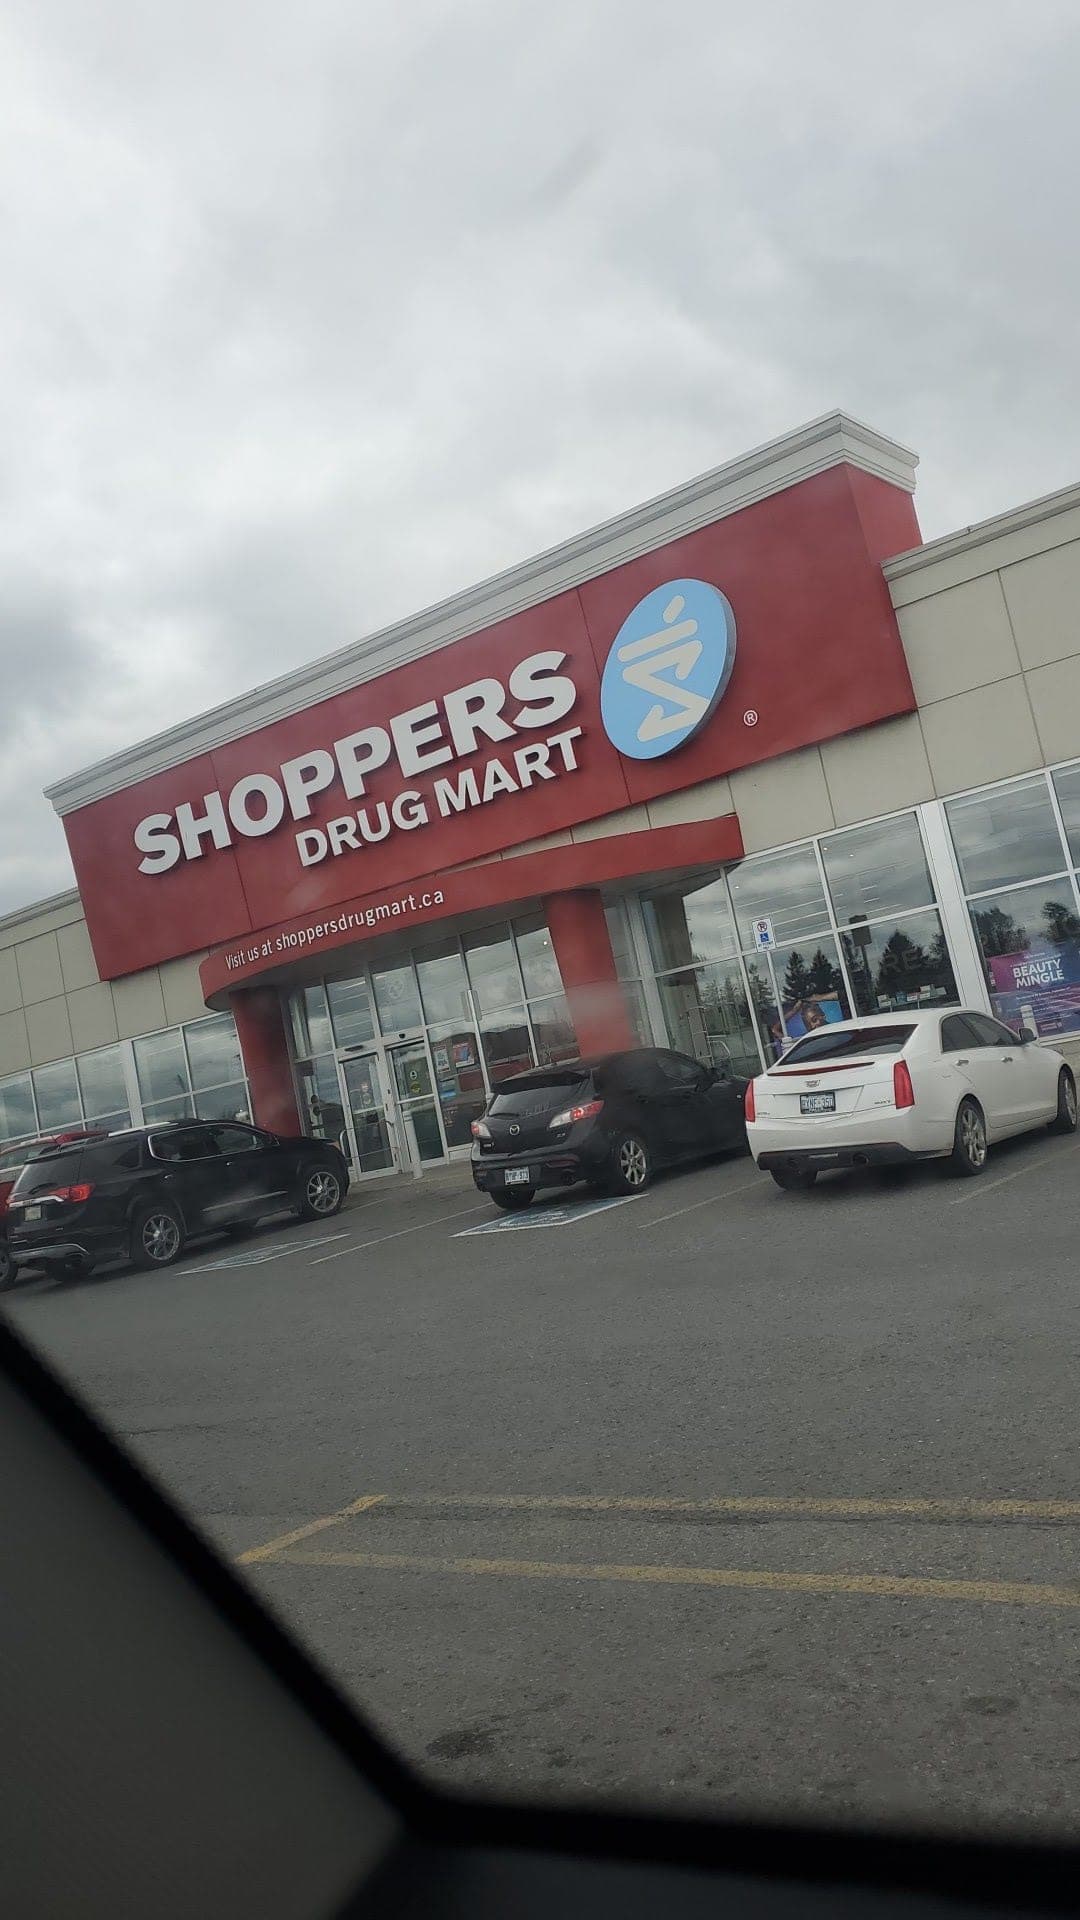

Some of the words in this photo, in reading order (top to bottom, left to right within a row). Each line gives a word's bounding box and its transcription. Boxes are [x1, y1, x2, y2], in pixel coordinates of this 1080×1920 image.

[134, 650, 577, 876] SHOPPERS
[295, 790, 429, 868] DRUG
[433, 727, 584, 818] MART
[225, 951, 246, 971] Visit
[247, 946, 260, 963] us
[261, 939, 273, 957] at
[275, 889, 445, 949] shoppersdrugmart.ca
[1013, 958, 1061, 979] BEAUTY
[1016, 969, 1065, 989] MINGLE
